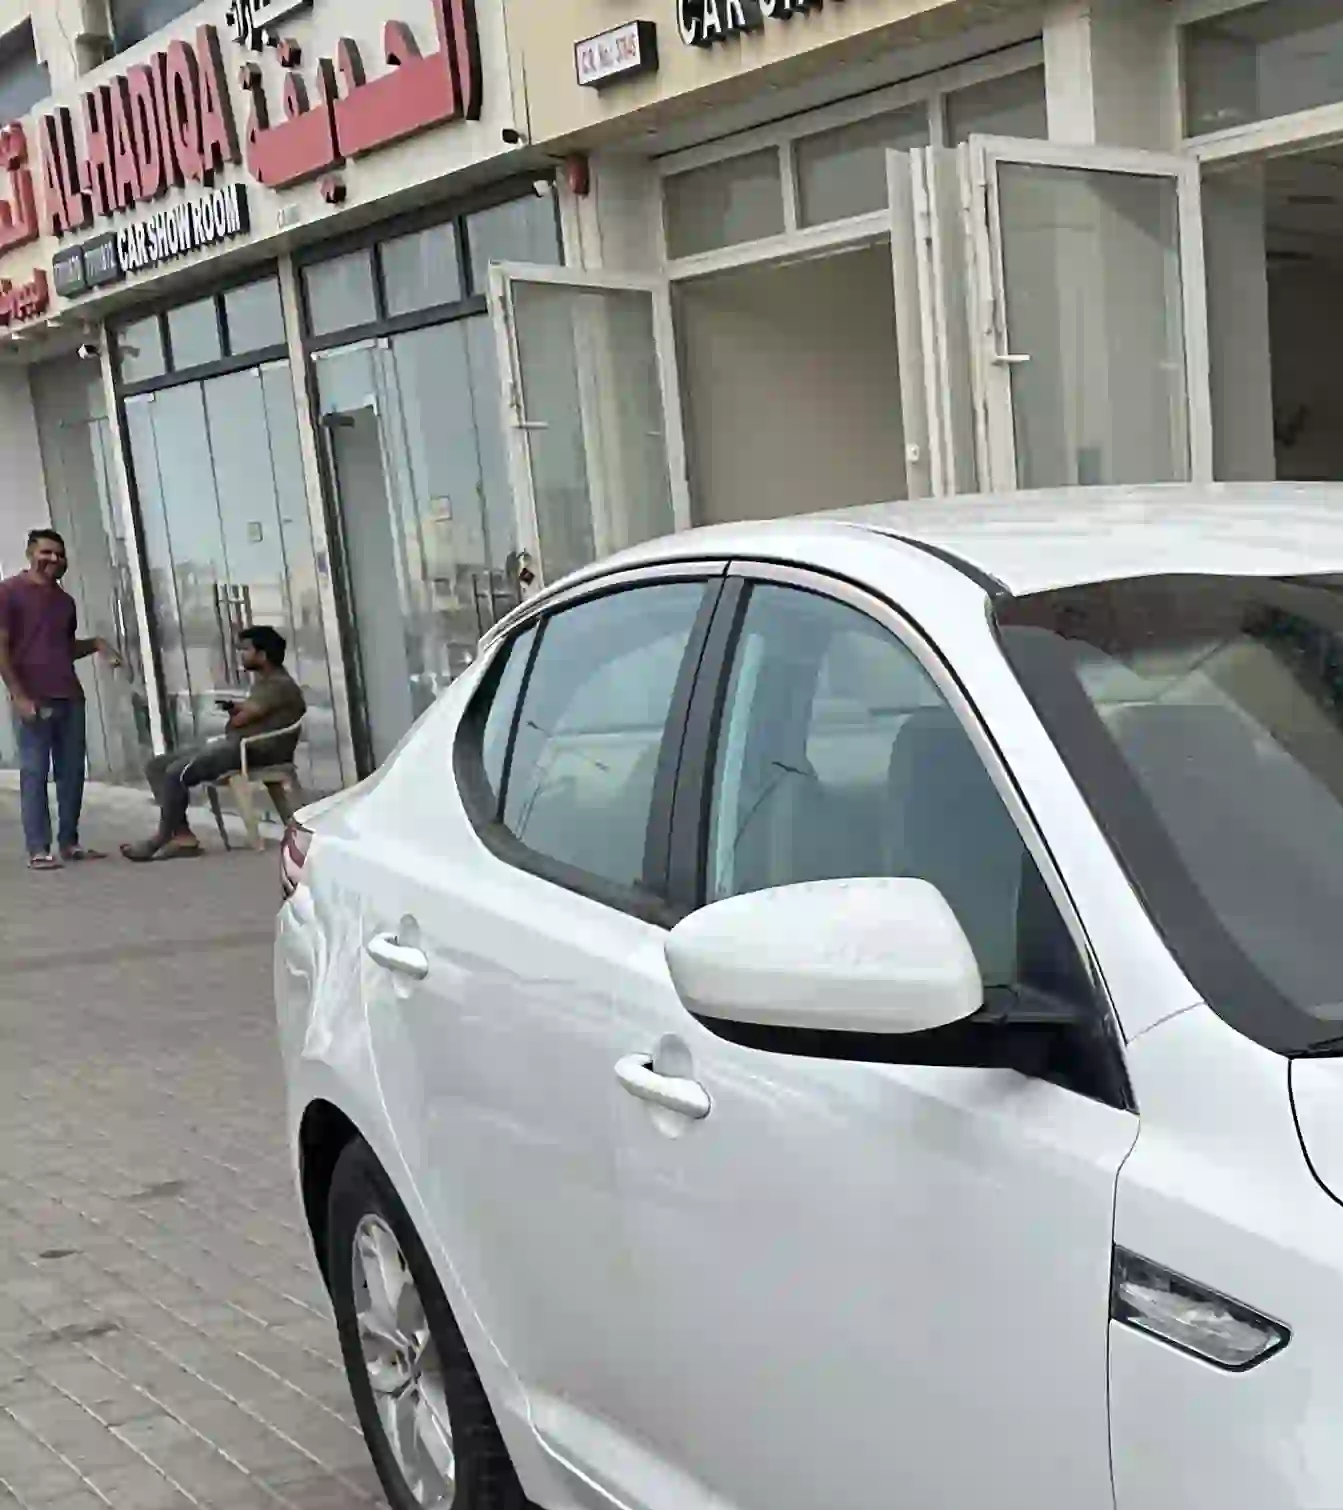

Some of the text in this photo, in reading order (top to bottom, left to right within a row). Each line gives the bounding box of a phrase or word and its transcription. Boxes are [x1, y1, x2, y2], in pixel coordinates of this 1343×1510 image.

[117, 222, 149, 271] CAR
[149, 203, 192, 261] SHOW
[192, 184, 243, 245] ROOM
